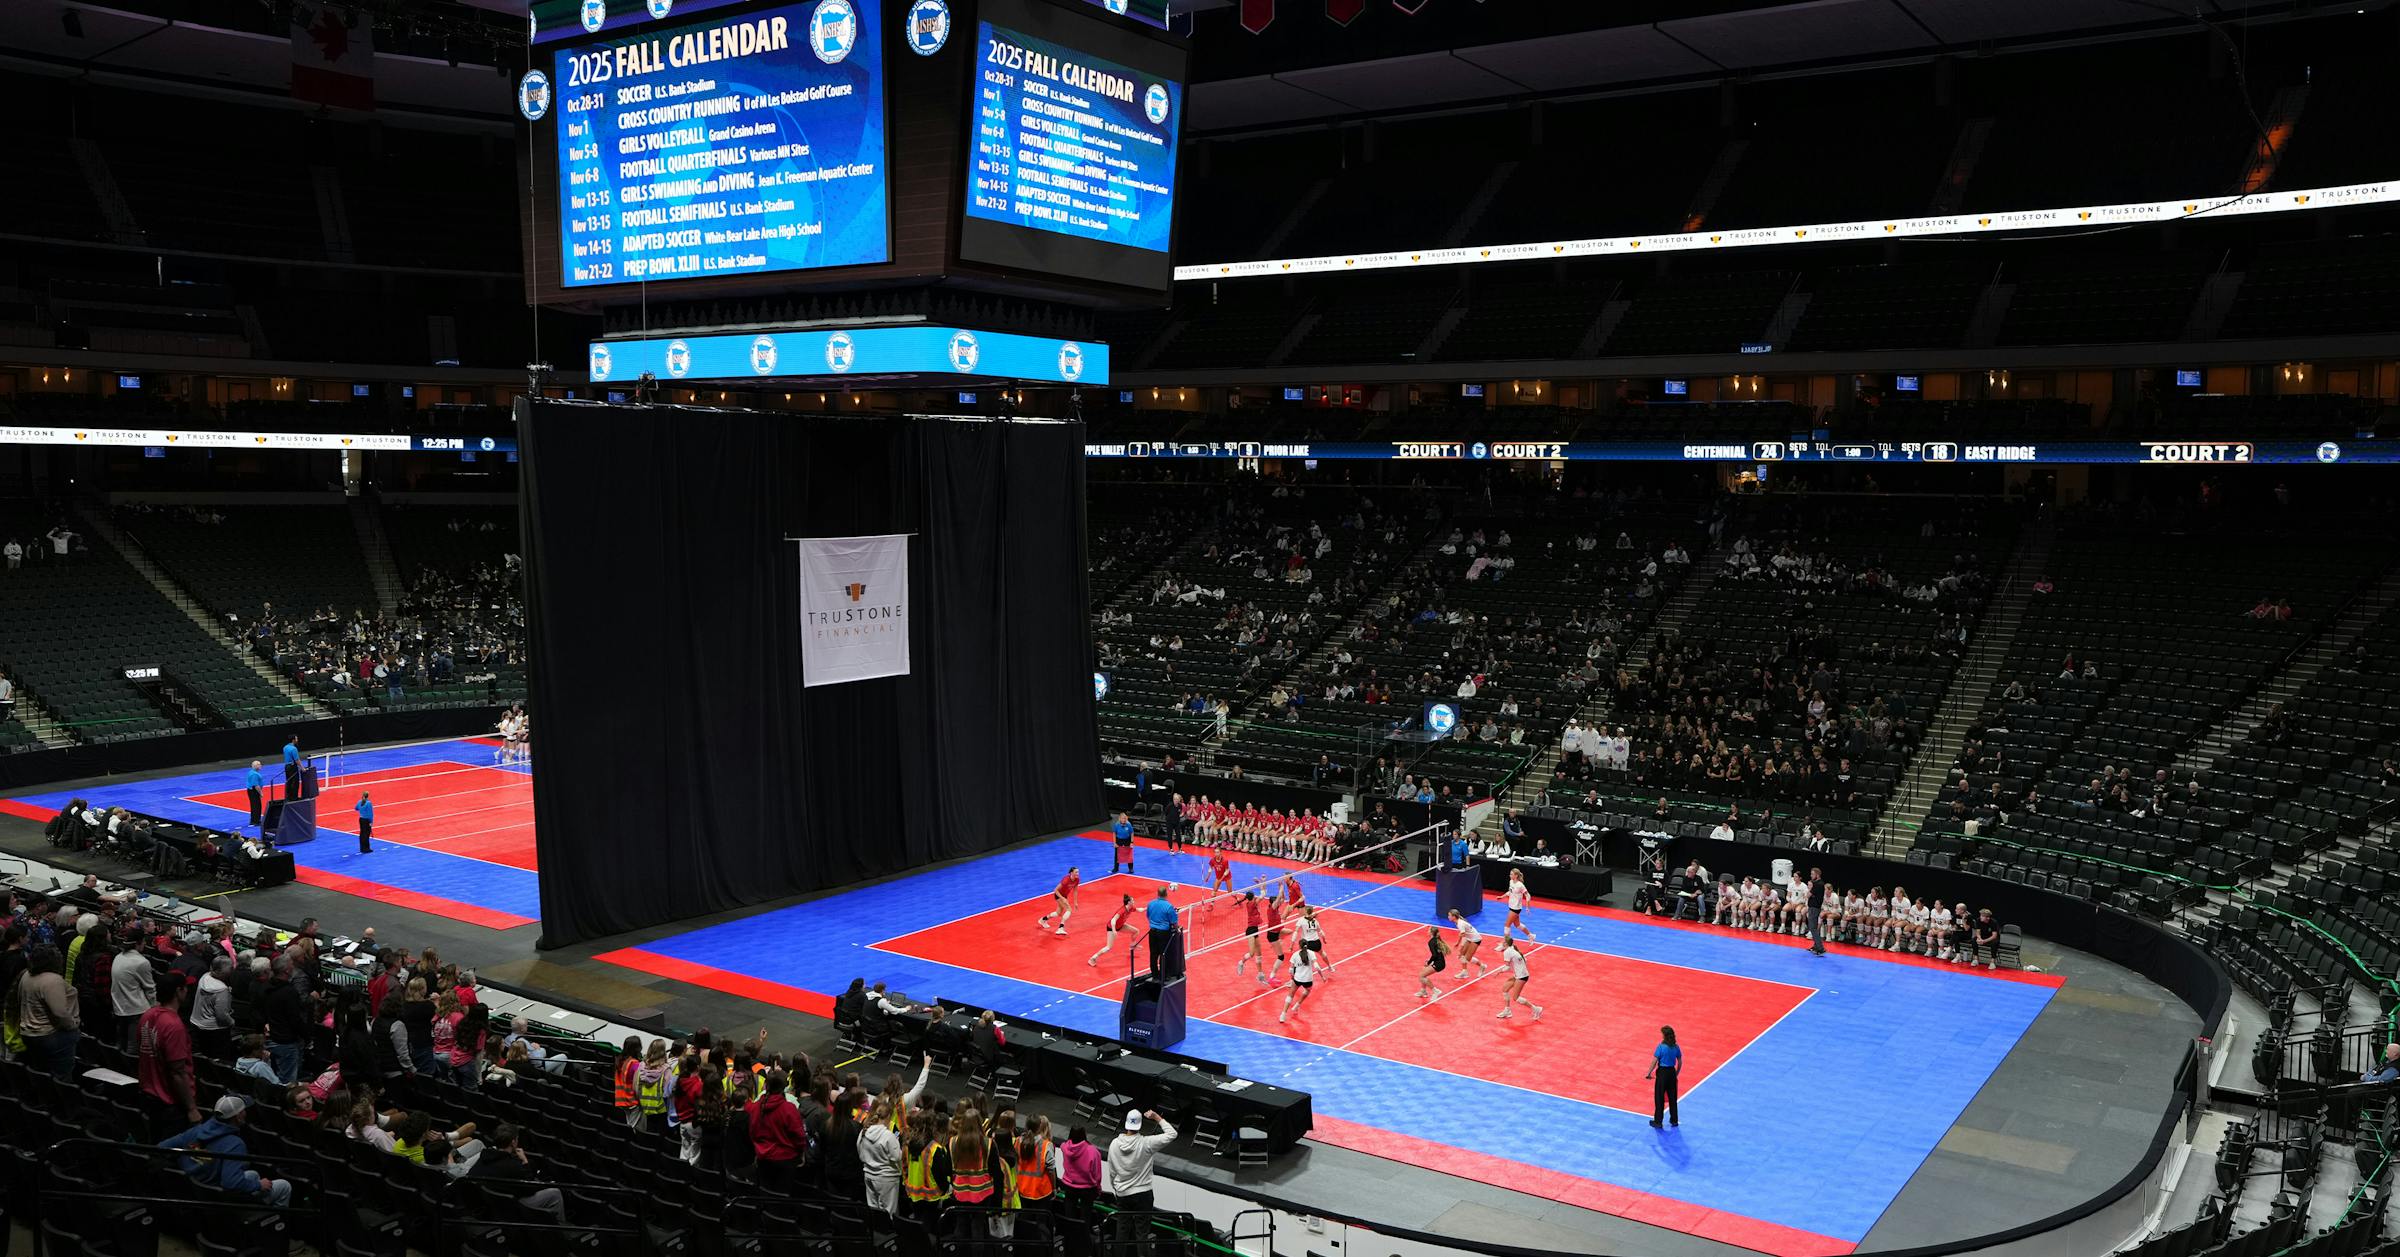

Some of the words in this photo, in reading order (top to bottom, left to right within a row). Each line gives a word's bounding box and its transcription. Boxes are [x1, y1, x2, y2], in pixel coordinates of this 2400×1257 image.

[569, 50, 612, 86] 2025
[616, 40, 665, 78] FALL
[669, 17, 788, 67] CALENDAR
[985, 70, 995, 82] Oct
[995, 72, 1013, 87] 28-31
[988, 40, 1023, 69] 2025
[1025, 50, 1059, 81] FALL
[1062, 63, 1134, 103] CALENDAR
[568, 100, 580, 113] Oct
[580, 93, 603, 111] 28-31
[617, 84, 652, 105] SOCCER
[655, 86, 668, 99] U.S.
[669, 82, 686, 97] Bank
[686, 79, 715, 93] Stadium
[984, 88, 995, 100] Nov
[569, 124, 583, 137] Nov
[583, 120, 588, 134] 1
[618, 110, 648, 129] CROSS
[648, 102, 692, 125] COUNTRY
[694, 95, 740, 118] RUNNING
[744, 98, 750, 110] U
[751, 96, 759, 109] of
[760, 95, 767, 108] M
[768, 94, 780, 107] Les
[781, 88, 809, 105] Bolstad
[809, 85, 826, 100] Golf
[826, 85, 852, 97] Course
[982, 106, 994, 117] Nov
[995, 108, 1006, 121] 5-8
[981, 124, 993, 136] Nov
[993, 126, 1004, 138] 6-8
[570, 148, 584, 161] Nov
[584, 143, 598, 159] 5-8
[619, 135, 646, 154] GIRLS
[646, 127, 705, 150] VOLLEYBALL
[709, 127, 730, 141] Grand
[730, 125, 754, 138] Casino
[754, 123, 776, 135] Arena
[980, 142, 992, 153] Nov
[993, 144, 1010, 158] 13-15
[570, 172, 585, 184] Nov
[585, 167, 599, 183] 6-8
[620, 158, 667, 179] FOOTBALL
[668, 147, 747, 174] QUARTERFINALS
[750, 148, 777, 162] Various
[778, 145, 790, 158] MN
[791, 144, 809, 157] Sites
[979, 160, 990, 171] Nov
[991, 161, 1009, 175] 13-15
[571, 196, 585, 209] Nov
[586, 190, 609, 207] 13-15
[621, 185, 648, 203] GIRLS
[649, 178, 702, 200] SWIMMING
[703, 180, 718, 194] AND
[719, 172, 755, 192] DIVING
[758, 175, 775, 187] Jean
[776, 173, 784, 185] K.
[785, 171, 817, 183] Freeman
[818, 165, 847, 182] Aquatic
[847, 164, 873, 176] Center
[978, 177, 989, 189] Nov
[990, 179, 1008, 193] 14-15
[2321, 186, 2386, 198] TRUSTONE
[976, 196, 988, 207] Nov
[988, 197, 1007, 210] 21-22
[2102, 205, 2161, 215] TRUSTONE
[572, 220, 586, 233] Nov
[587, 215, 611, 231] 13-15
[622, 208, 668, 228] FOOTBALL
[669, 201, 727, 223] SEMIFINALS
[730, 203, 744, 216] U.S.
[745, 201, 763, 215] Bank
[764, 199, 794, 213] Stadium
[1905, 219, 1959, 228] TRUSTONE
[2001, 213, 2057, 222] TRUSTONE
[1815, 225, 1865, 233] TRUSTONE
[574, 243, 588, 256] Nov
[588, 239, 612, 255] 14-15
[623, 233, 665, 252] ADAPTED
[666, 229, 701, 248] SOCCER
[704, 232, 726, 244] White
[726, 230, 743, 242] Bear
[743, 228, 760, 241] Lake
[761, 227, 778, 239] Area
[779, 224, 796, 240] High
[797, 221, 822, 236] School
[1571, 241, 1614, 249] TRUSTONE
[1648, 236, 1693, 244] TRUSTONE
[1497, 246, 1538, 254] TRUSTONE
[574, 268, 589, 280] Nov
[589, 263, 613, 279] 21-22
[624, 259, 648, 276] PREP
[649, 257, 677, 274] BOWL
[678, 255, 700, 272] XLIII
[704, 257, 717, 270] U.S.
[718, 256, 736, 269] Bank
[736, 254, 766, 267] Stadium
[422, 438, 447, 449] 12:25
[449, 439, 464, 449] PM
[1085, 445, 1100, 455] PPLE
[1101, 445, 1125, 455] VALLEY
[1136, 444, 1142, 455] 7
[1246, 444, 1252, 456] 9
[1263, 445, 1288, 456] PRIOR
[1289, 445, 1309, 456] LAKE
[1400, 445, 1450, 457] COURT
[1454, 445, 1461, 457] 1
[1493, 445, 1547, 457] COURT
[1551, 445, 1561, 457] 2
[1684, 445, 1746, 459] CENTENNIAL
[1761, 445, 1777, 459] 24
[1789, 443, 1808, 451] SETS
[1901, 443, 1921, 451] SETS
[1965, 446, 1996, 460] EAST
[1997, 446, 2036, 460] RIDGE
[2150, 445, 2229, 461] COURT
[2235, 445, 2249, 461] 2
[808, 605, 903, 625] TRUSTONE
[817, 624, 894, 639] FINANCIAL
